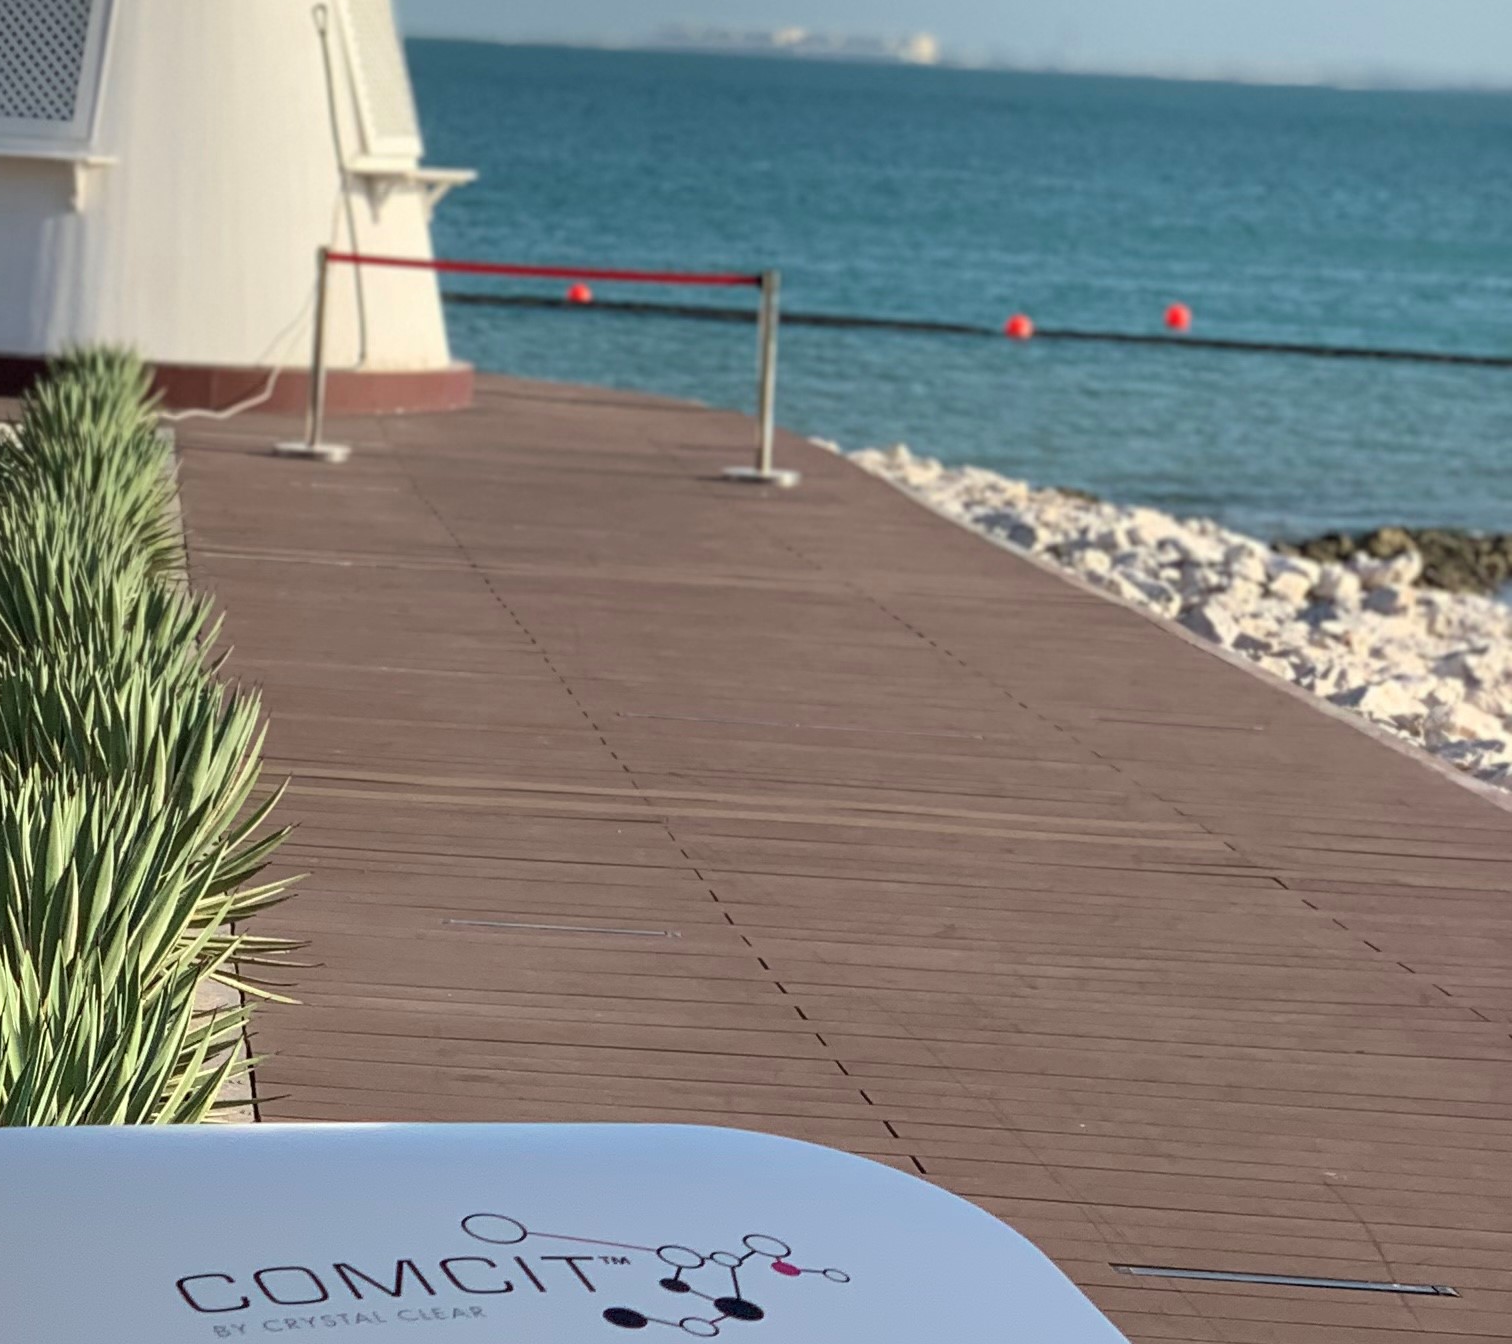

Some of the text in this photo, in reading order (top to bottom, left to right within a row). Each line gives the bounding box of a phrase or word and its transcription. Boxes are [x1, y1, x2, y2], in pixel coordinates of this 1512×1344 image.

[212, 1305, 489, 1339] BY CRYSTAL CLEAR
